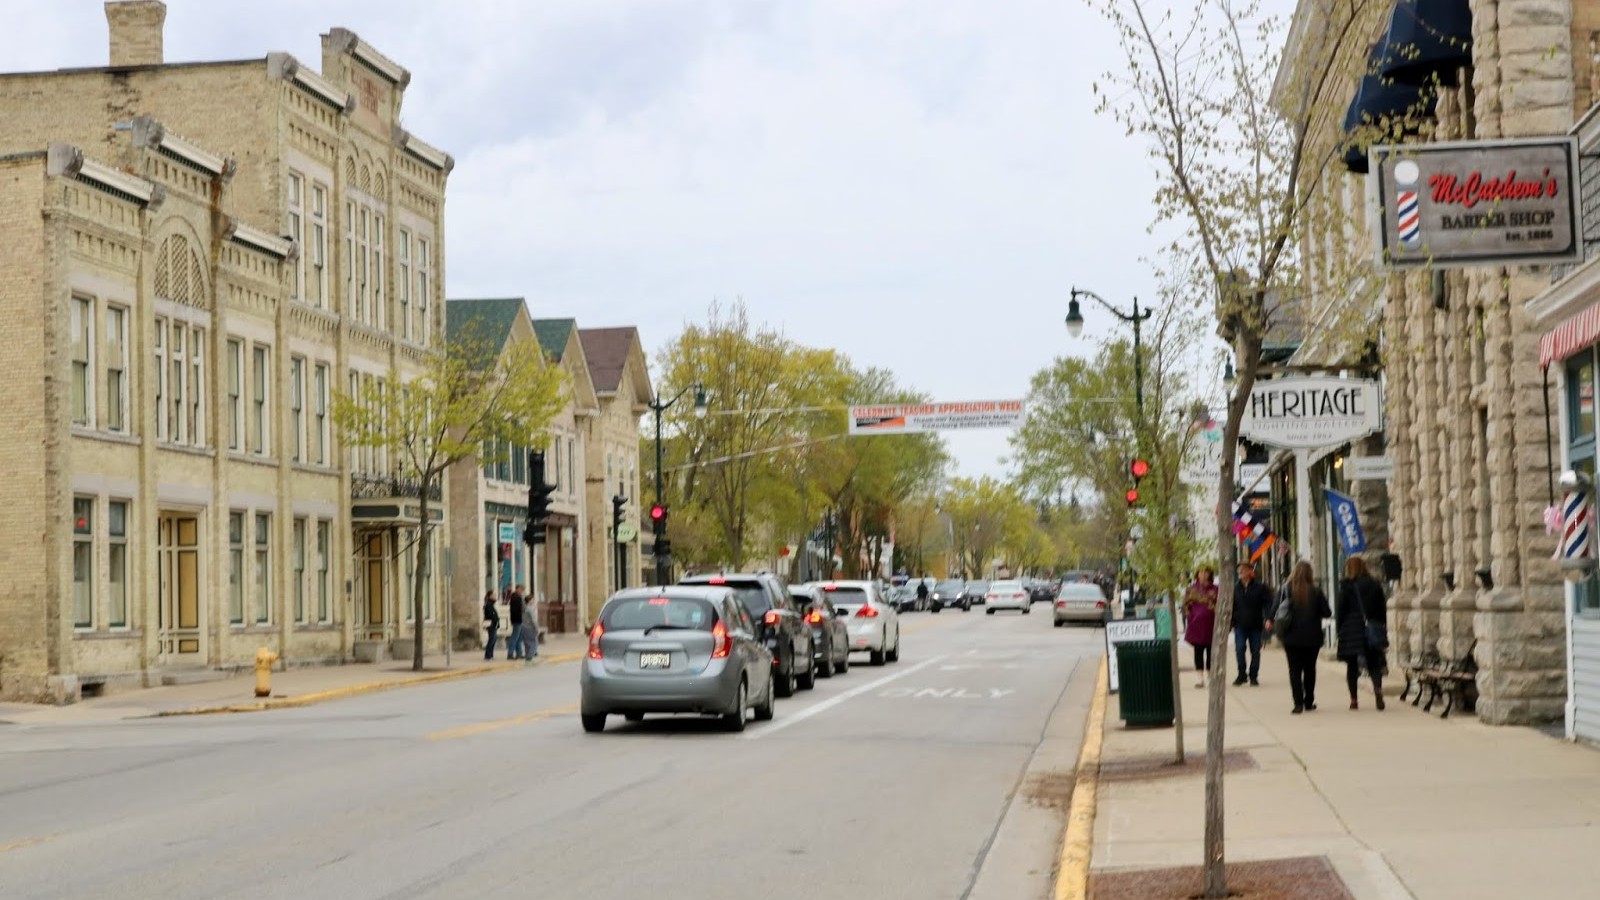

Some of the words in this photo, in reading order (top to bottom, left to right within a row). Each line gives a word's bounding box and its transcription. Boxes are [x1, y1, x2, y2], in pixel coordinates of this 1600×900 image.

[1428, 167, 1557, 208] McCutcheon's
[1509, 209, 1555, 227] SHOP
[852, 406, 897, 418] CELEBRATE
[900, 404, 935, 416] TEACHER
[939, 402, 995, 414] APPRECIATION
[999, 400, 1021, 412] WEEK
[1252, 387, 1365, 418] HERITAGE
[1338, 502, 1360, 548] OPEN
[877, 687, 1017, 699] ONLY
